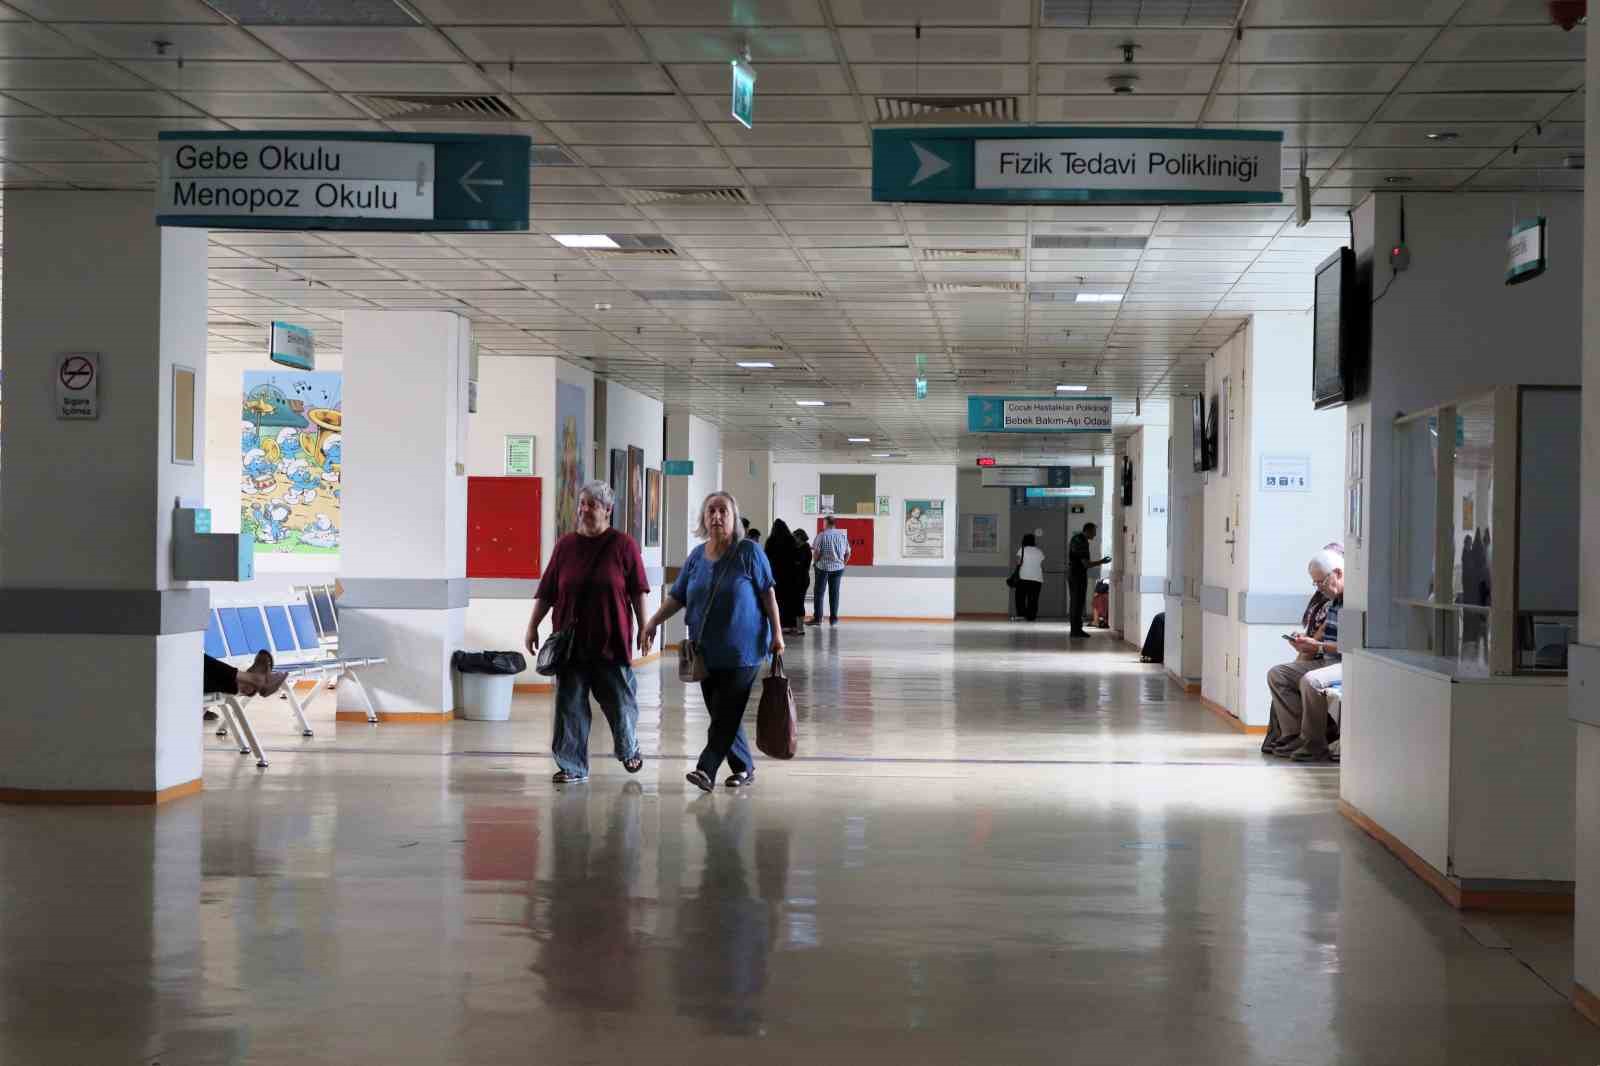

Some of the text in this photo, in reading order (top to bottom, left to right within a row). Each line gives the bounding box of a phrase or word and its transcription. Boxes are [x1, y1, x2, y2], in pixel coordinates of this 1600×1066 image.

[176, 144, 341, 171] Gebe Okulu
[999, 152, 1258, 182] Fizik Tedavi Polikliniği
[173, 182, 398, 212] Menopoz Okulu
[1005, 415, 1032, 425] Bebek
